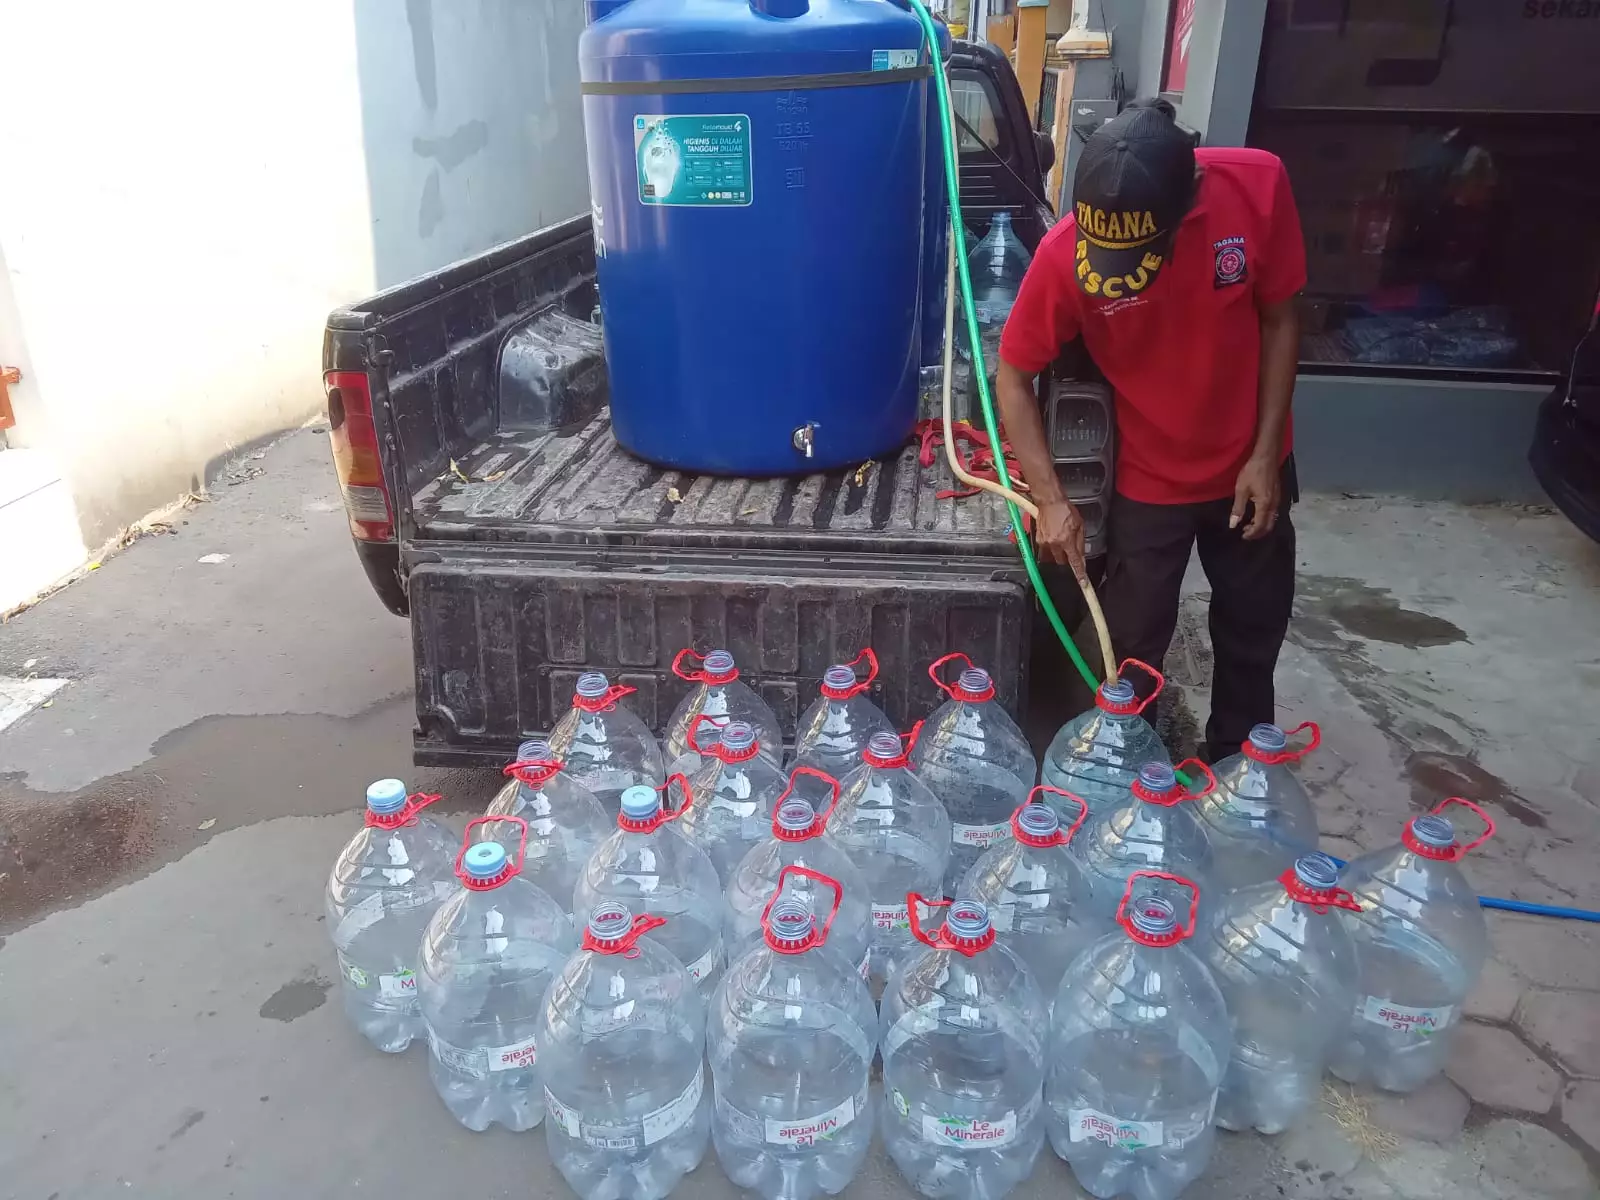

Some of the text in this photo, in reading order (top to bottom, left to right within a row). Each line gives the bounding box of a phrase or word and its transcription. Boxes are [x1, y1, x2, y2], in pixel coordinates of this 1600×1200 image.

[687, 145, 719, 153] TANGGUH
[1077, 200, 1157, 239] TAGANA
[1076, 240, 1162, 298] RESCUE
[963, 829, 1007, 841] Minerale
[877, 920, 891, 929] Le
[1378, 1007, 1437, 1027] Minerale
[1392, 1021, 1409, 1033] Le
[519, 1054, 534, 1069] Le
[780, 1116, 837, 1139] Minerale
[945, 1125, 1005, 1140] Minerale
[973, 1120, 990, 1132] Le
[1081, 1117, 1140, 1140] Minerale
[797, 1135, 813, 1145] Le
[1096, 1129, 1113, 1148] Le
